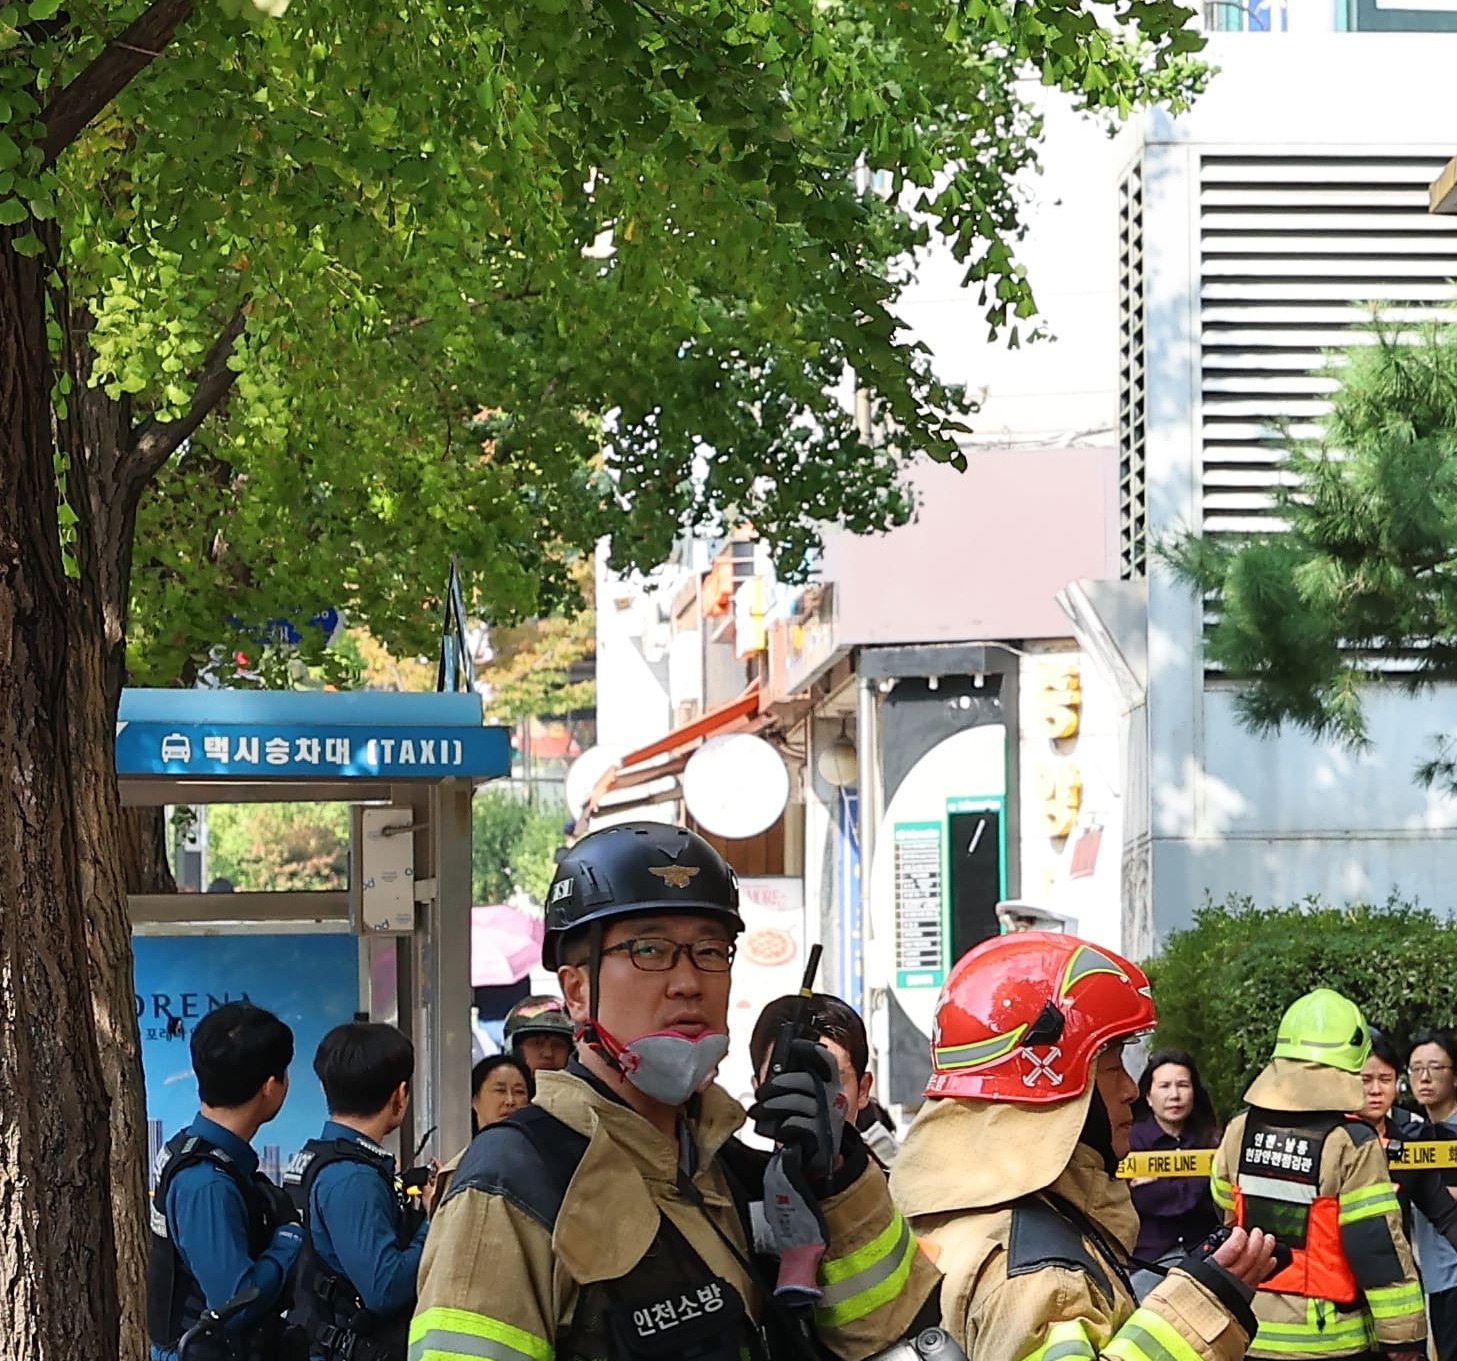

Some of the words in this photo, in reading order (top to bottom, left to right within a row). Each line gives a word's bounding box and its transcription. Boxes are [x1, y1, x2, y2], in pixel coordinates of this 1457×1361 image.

[367, 738, 463, 765] (TAXI)
[1148, 1156, 1171, 1173] FIRE
[1174, 1154, 1197, 1172] LINE
[1413, 1147, 1436, 1163] LINE
[633, 1281, 725, 1339] 인천소방
